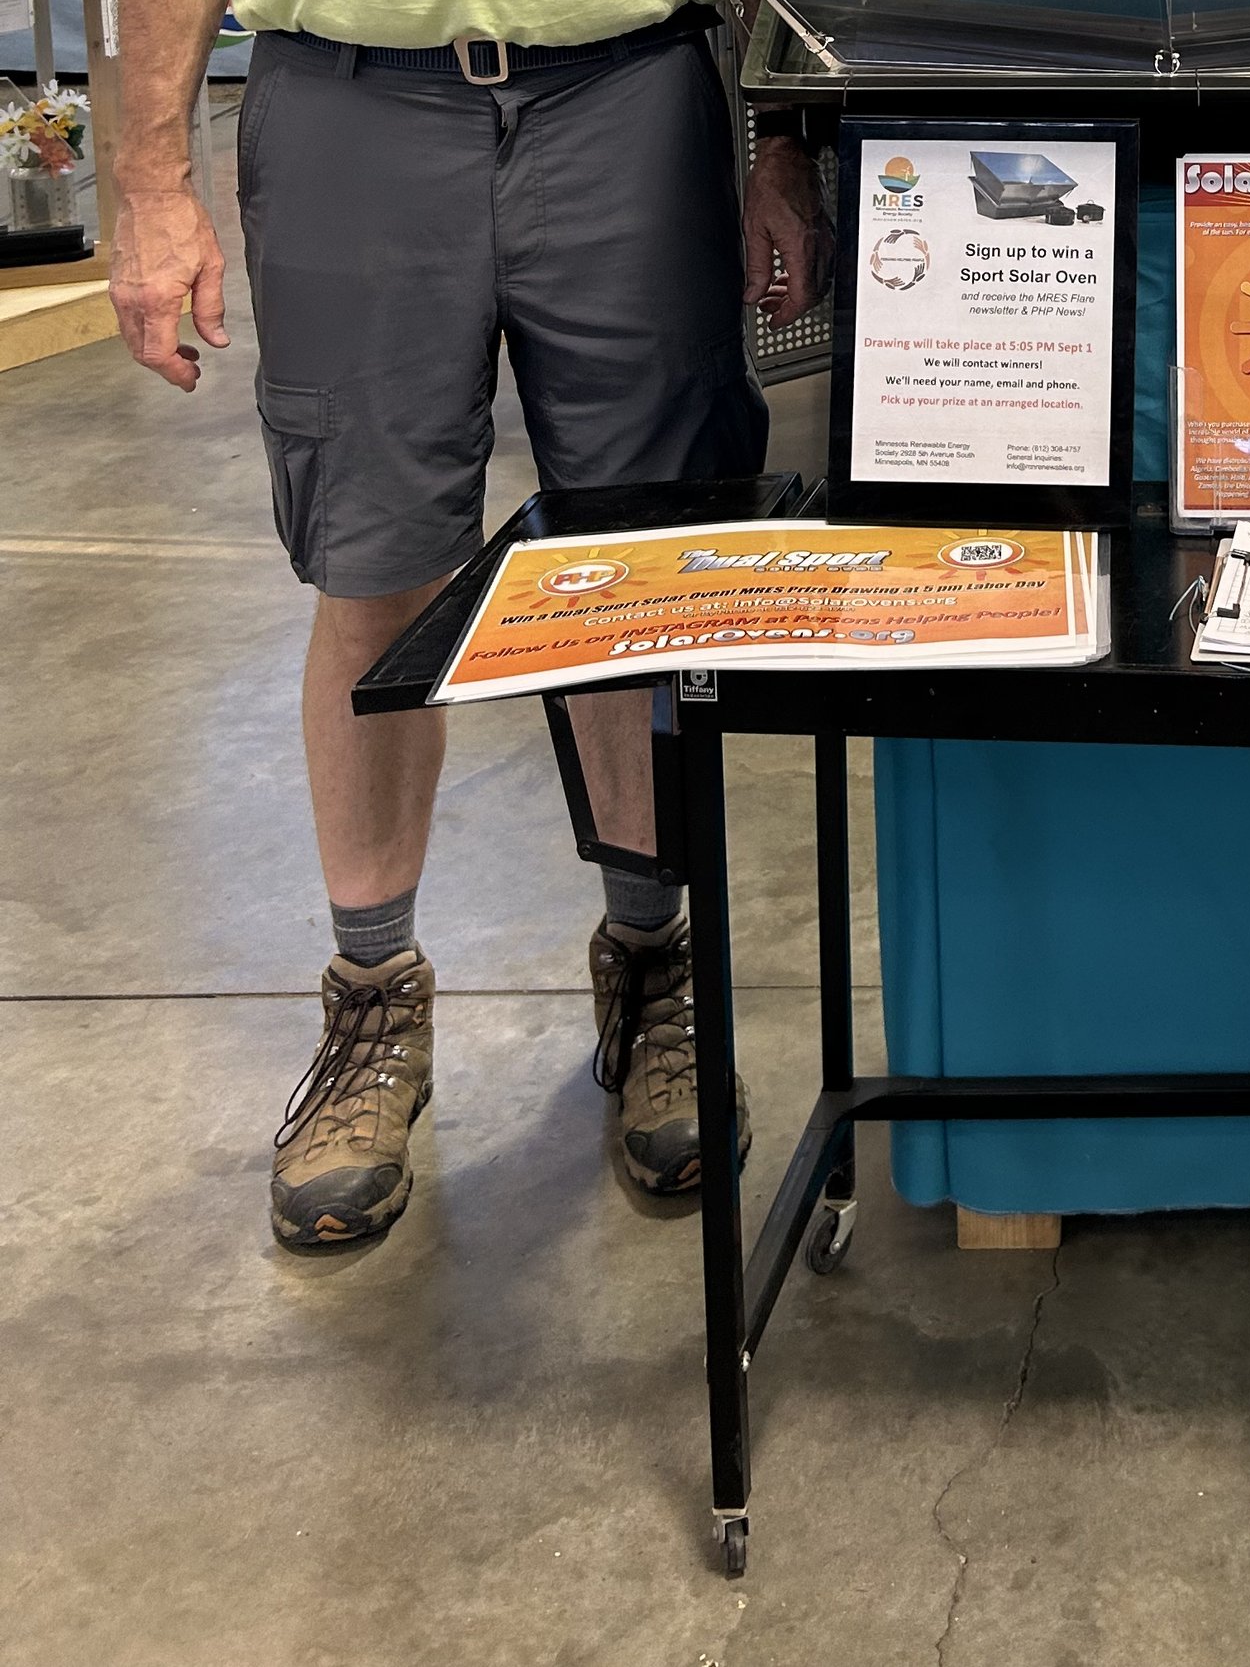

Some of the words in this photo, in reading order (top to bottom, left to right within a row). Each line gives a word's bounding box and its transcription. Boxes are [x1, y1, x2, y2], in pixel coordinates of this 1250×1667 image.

[873, 194, 924, 207] MRES
[965, 243, 1001, 260] Sign
[1006, 247, 1026, 260] up
[1031, 245, 1047, 258] to
[1052, 245, 1080, 259] win
[1084, 249, 1094, 259] a
[960, 268, 1004, 284] Sport
[1008, 269, 1051, 283] Solar
[1055, 270, 1097, 284] Oven
[961, 292, 981, 301] and
[981, 292, 1016, 301] receive
[1019, 293, 1034, 302] the
[1036, 293, 1068, 303] MRES
[1070, 294, 1095, 303] Flare
[969, 305, 1018, 315] newsletter
[1020, 306, 1028, 315] &
[1030, 306, 1054, 316] PHP
[1055, 307, 1086, 317] News!
[864, 337, 910, 350] Drawing
[913, 338, 933, 349] will
[936, 339, 960, 350] take
[963, 340, 992, 352] place
[995, 342, 1007, 351] at
[1009, 341, 1033, 351] 5:05
[1036, 342, 1055, 352] PM
[1058, 343, 1083, 354] Sept
[1086, 343, 1093, 353] 1
[924, 358, 940, 367] We
[943, 358, 960, 367] will
[962, 359, 998, 368] contact
[1001, 360, 1043, 369] winners!
[913, 377, 937, 387] need
[939, 379, 961, 388] your
[964, 380, 994, 389] name,
[996, 379, 1023, 388] email
[1026, 380, 1044, 389] and
[1046, 380, 1080, 391] phone.
[881, 395, 901, 405] Pick
[903, 398, 915, 406] up
[917, 397, 939, 406] your
[942, 397, 966, 407] prize
[968, 398, 979, 406] at
[981, 399, 993, 407] an
[995, 399, 1038, 409] arranged
[1041, 399, 1083, 409] location.
[948, 442, 970, 450] Energy
[678, 551, 780, 574] Dual
[778, 549, 892, 567] Sport
[552, 566, 616, 586] PHP
[500, 614, 536, 626] Win
[550, 606, 590, 619] Dual
[591, 600, 640, 614] Sport
[640, 595, 687, 607] Solar
[689, 588, 737, 600] Oven!
[739, 586, 785, 595] MRES
[787, 585, 828, 594] Prize
[831, 586, 900, 596] Drawing
[902, 585, 919, 594] at
[922, 585, 935, 593] 5
[936, 584, 963, 593] pm
[966, 581, 1011, 590] Labor
[1014, 579, 1046, 589] Day
[584, 607, 665, 627] Contact
[670, 605, 696, 614] us
[700, 601, 728, 611] at:
[469, 644, 547, 662] Follow
[551, 639, 581, 650] Us
[584, 634, 617, 645] on
[619, 616, 761, 639] INSTAGRAM
[764, 615, 789, 624] at
[793, 614, 881, 625] Persons
[885, 612, 971, 626] Helping
[976, 607, 1061, 620] People!
[608, 627, 915, 656] SolarOvens.org
[683, 685, 714, 694] Tiffany
